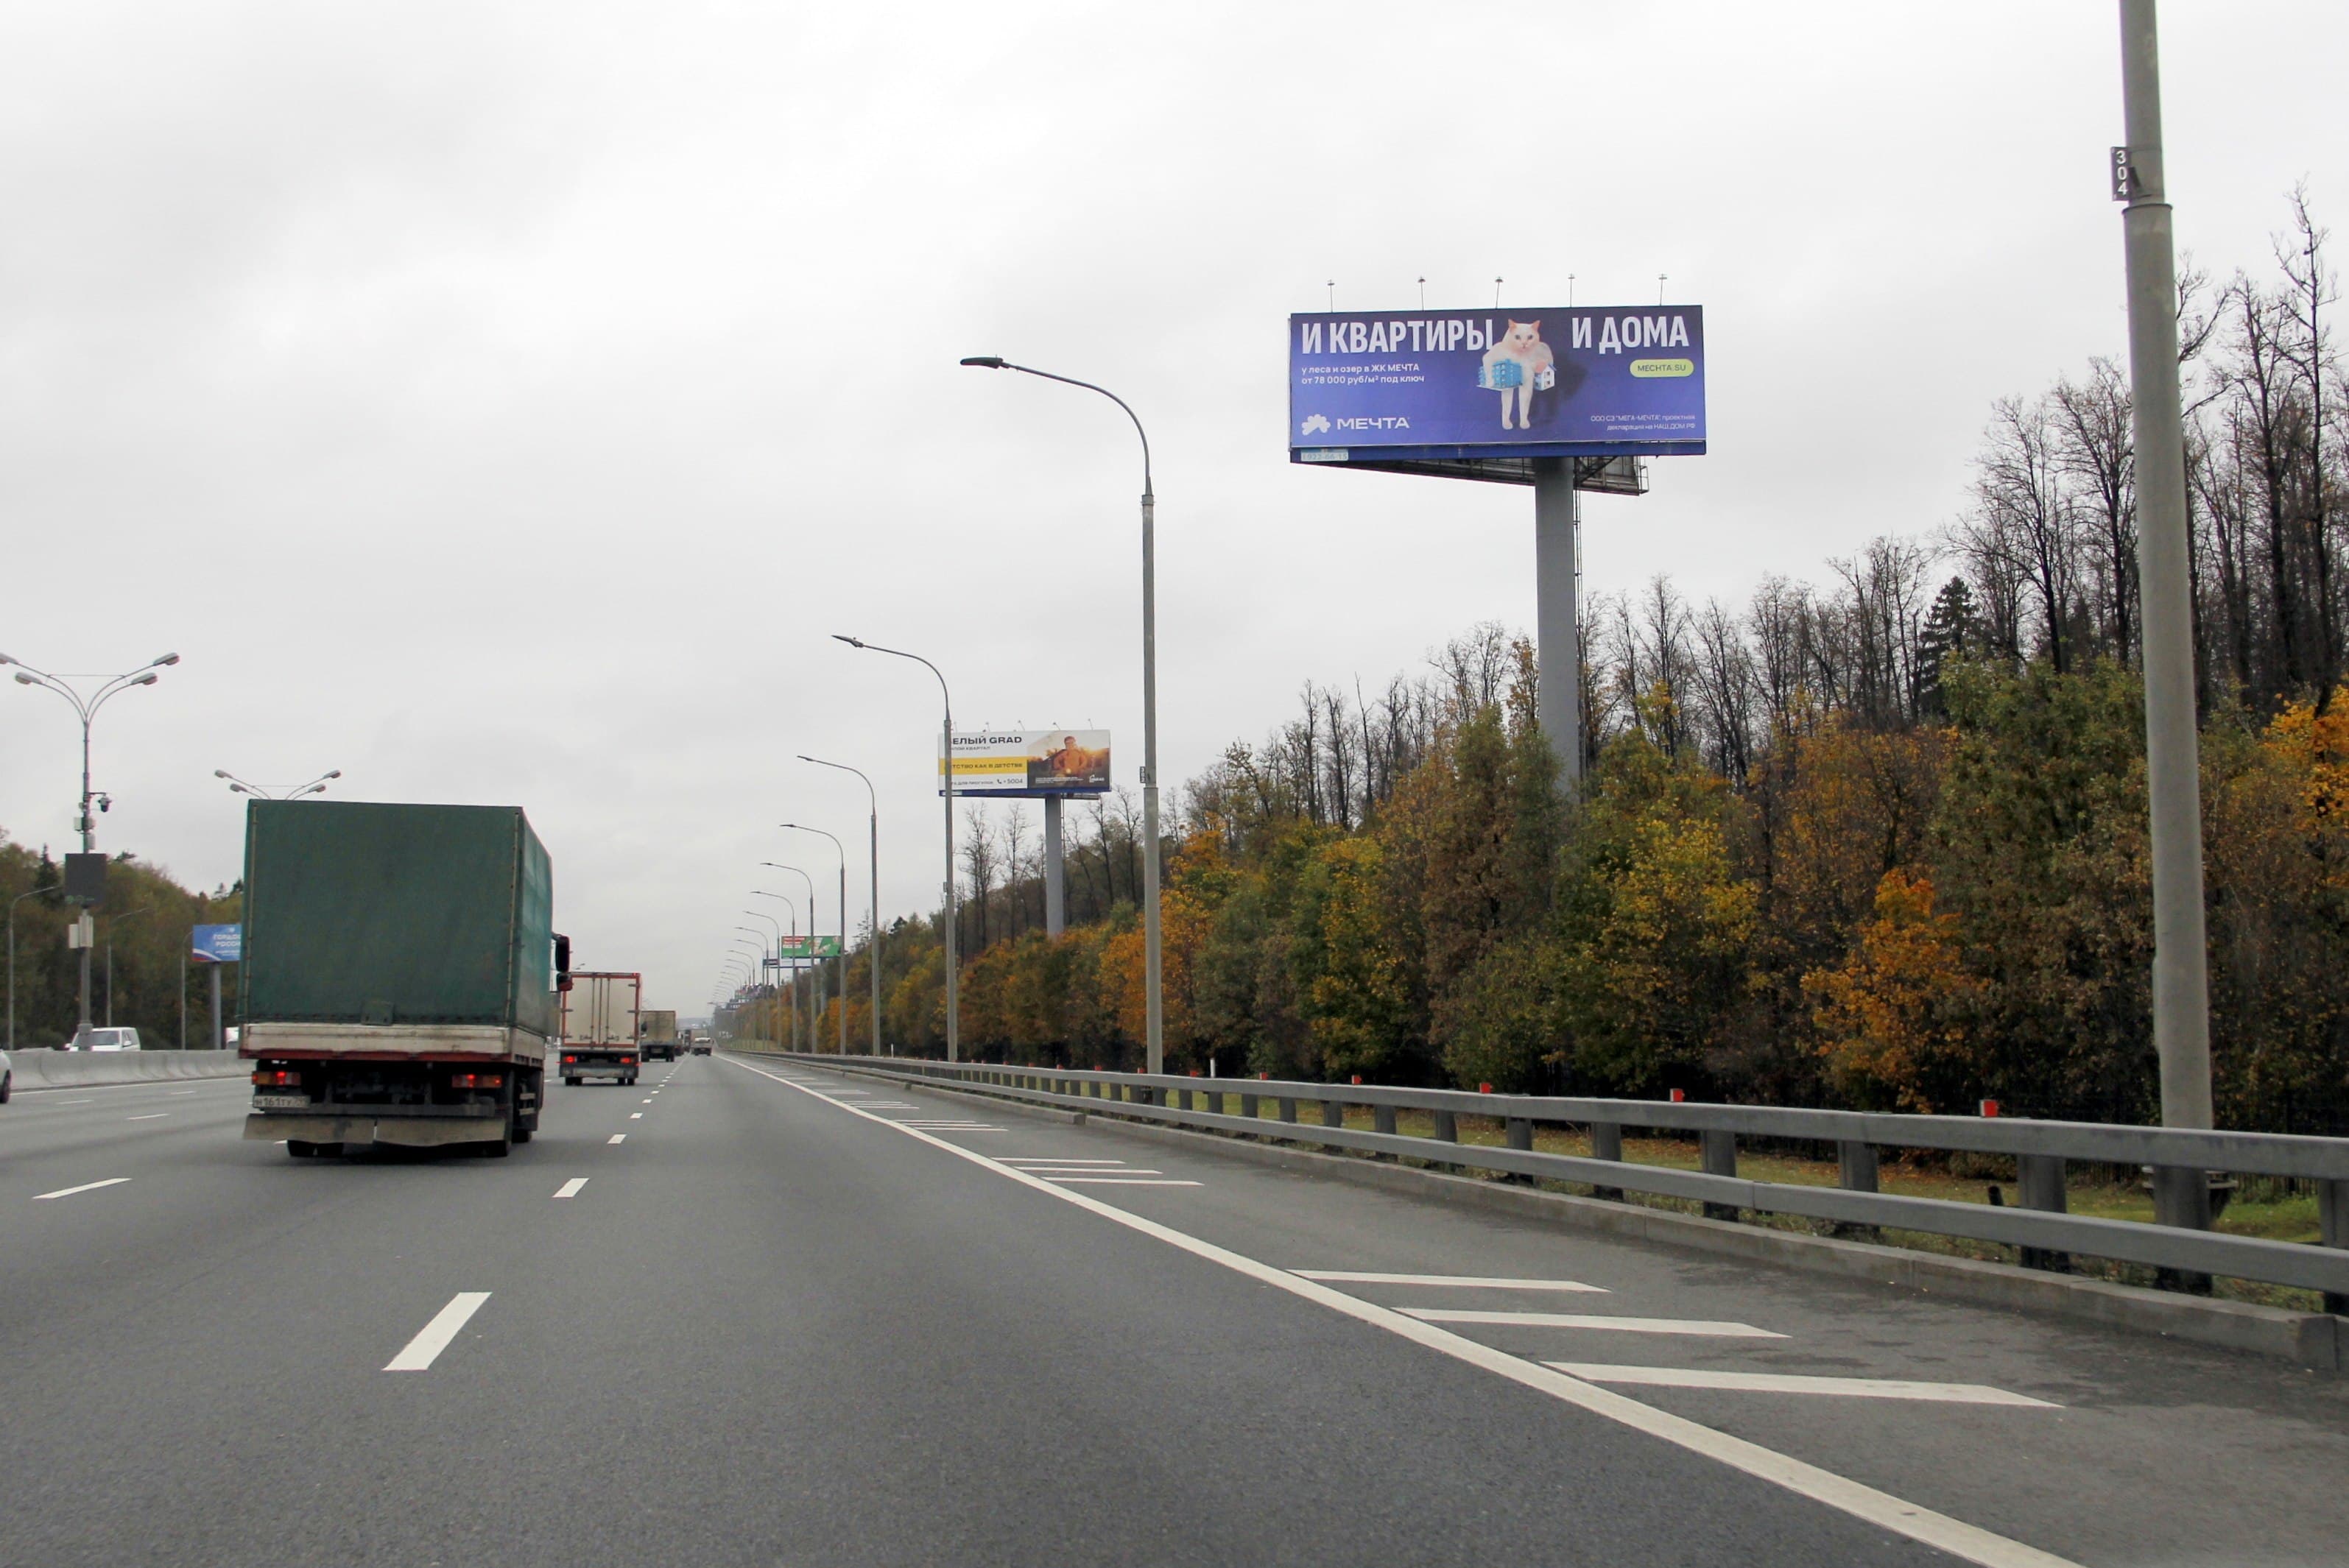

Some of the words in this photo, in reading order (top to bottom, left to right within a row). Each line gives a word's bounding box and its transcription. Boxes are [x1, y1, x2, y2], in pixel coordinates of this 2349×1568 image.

[2116, 150, 2128, 195] 304
[1302, 322, 1322, 354] И
[1329, 319, 1493, 353] КВАРТИРЫ
[1572, 317, 1592, 348] И
[1599, 316, 1690, 354] ДОМА
[1302, 367, 1307, 375] у
[1340, 365, 1362, 374] озер
[1388, 363, 1420, 372] МЕЧТА
[1637, 364, 1686, 372] MECHTA.SU
[1381, 375, 1398, 384] под
[1401, 375, 1425, 383] ключ
[1336, 417, 1410, 430] МЕЧТА
[952, 735, 987, 745] ЕЛЫЙ
